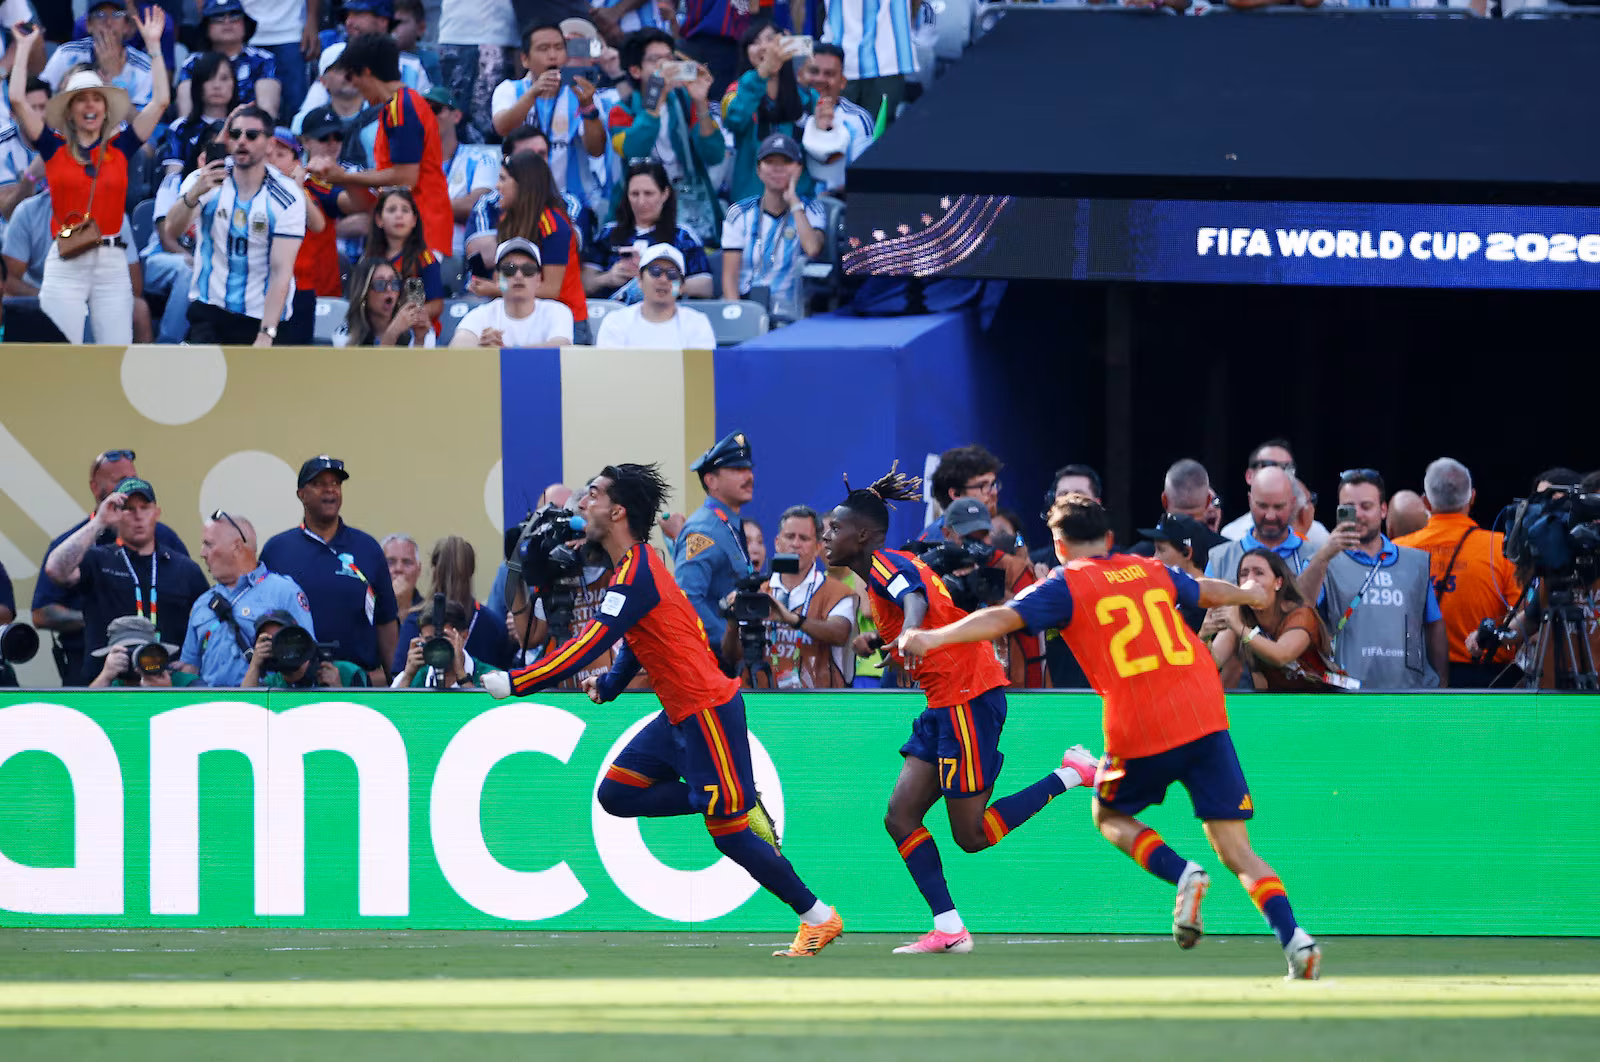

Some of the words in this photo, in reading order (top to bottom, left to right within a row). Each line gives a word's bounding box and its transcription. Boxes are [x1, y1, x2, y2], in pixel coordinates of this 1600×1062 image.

[1197, 227, 1272, 257] FIFA
[1276, 228, 1404, 260] WORLD
[1409, 231, 1481, 261] CUP
[1486, 233, 1600, 263] 2026
[1103, 564, 1147, 584] PEDRI
[1096, 588, 1195, 678] 20
[938, 757, 957, 789] 17
[703, 785, 719, 815] 7
